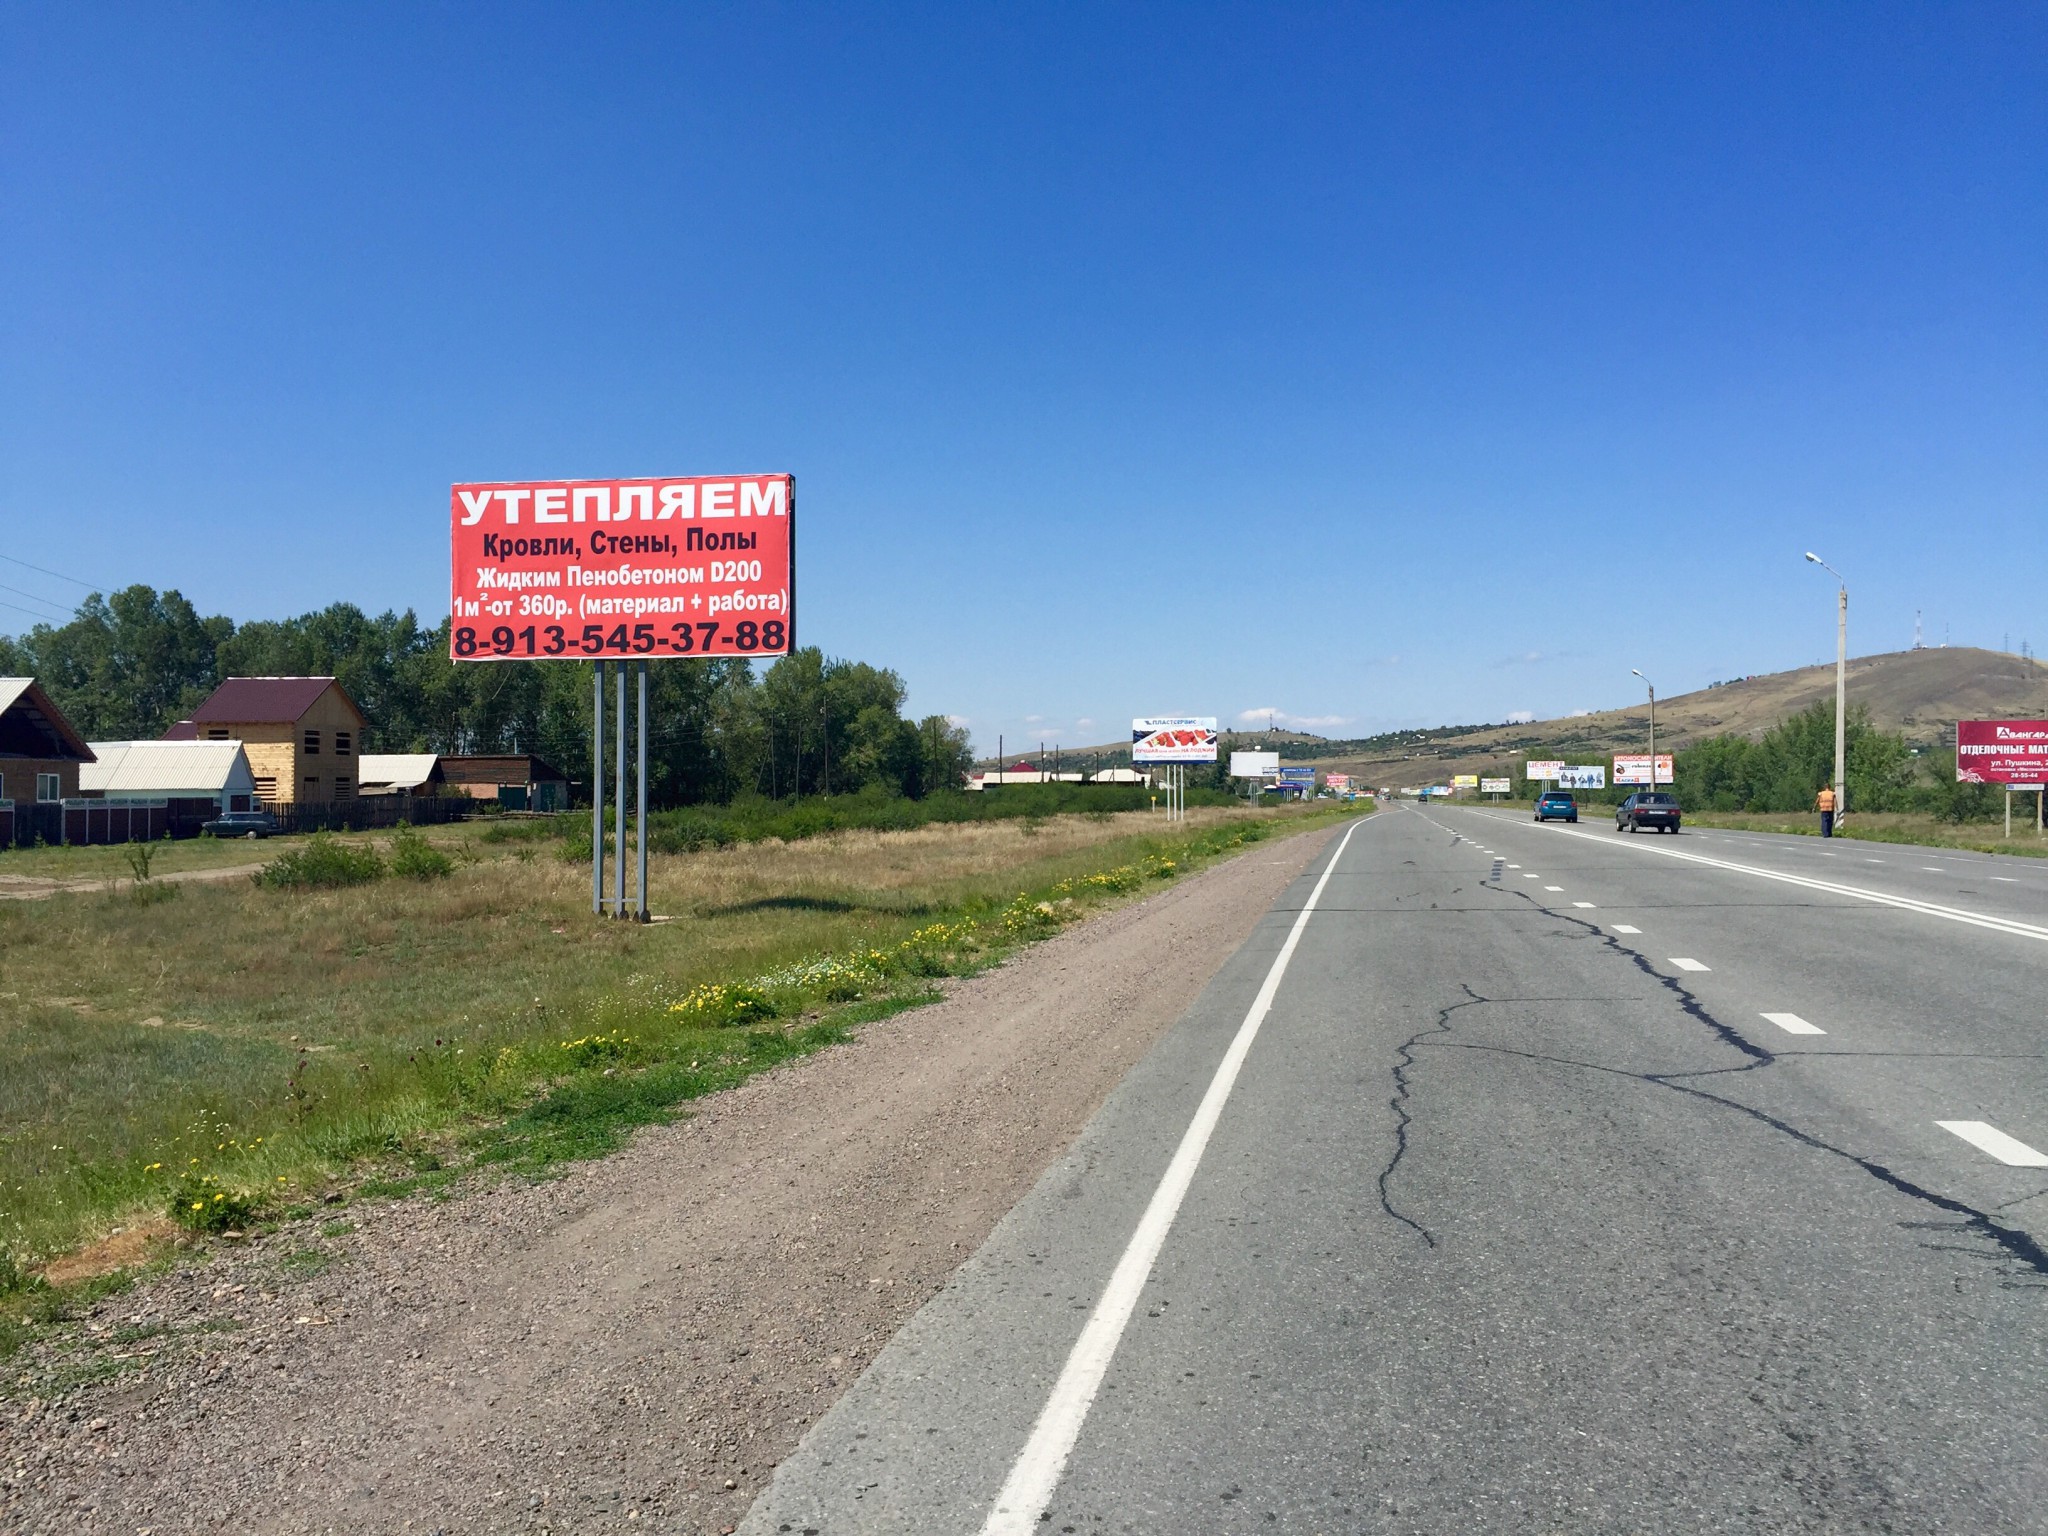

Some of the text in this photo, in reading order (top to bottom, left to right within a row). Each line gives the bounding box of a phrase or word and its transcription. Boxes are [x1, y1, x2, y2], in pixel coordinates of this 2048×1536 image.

[457, 480, 786, 526] УТЕПЛЯЕМ
[484, 527, 757, 562] Кровли, Стены, Полы
[476, 560, 762, 591] Жидким Пенобетоном D200
[519, 594, 573, 620] 360р.
[579, 592, 685, 620] (материал
[709, 588, 787, 616] работа)
[454, 620, 786, 656] 8-913-545-37-88
[1960, 745, 2025, 755] ОТДЕЛОЧНЫЕ
[2005, 759, 2044, 767] Пушкина,
